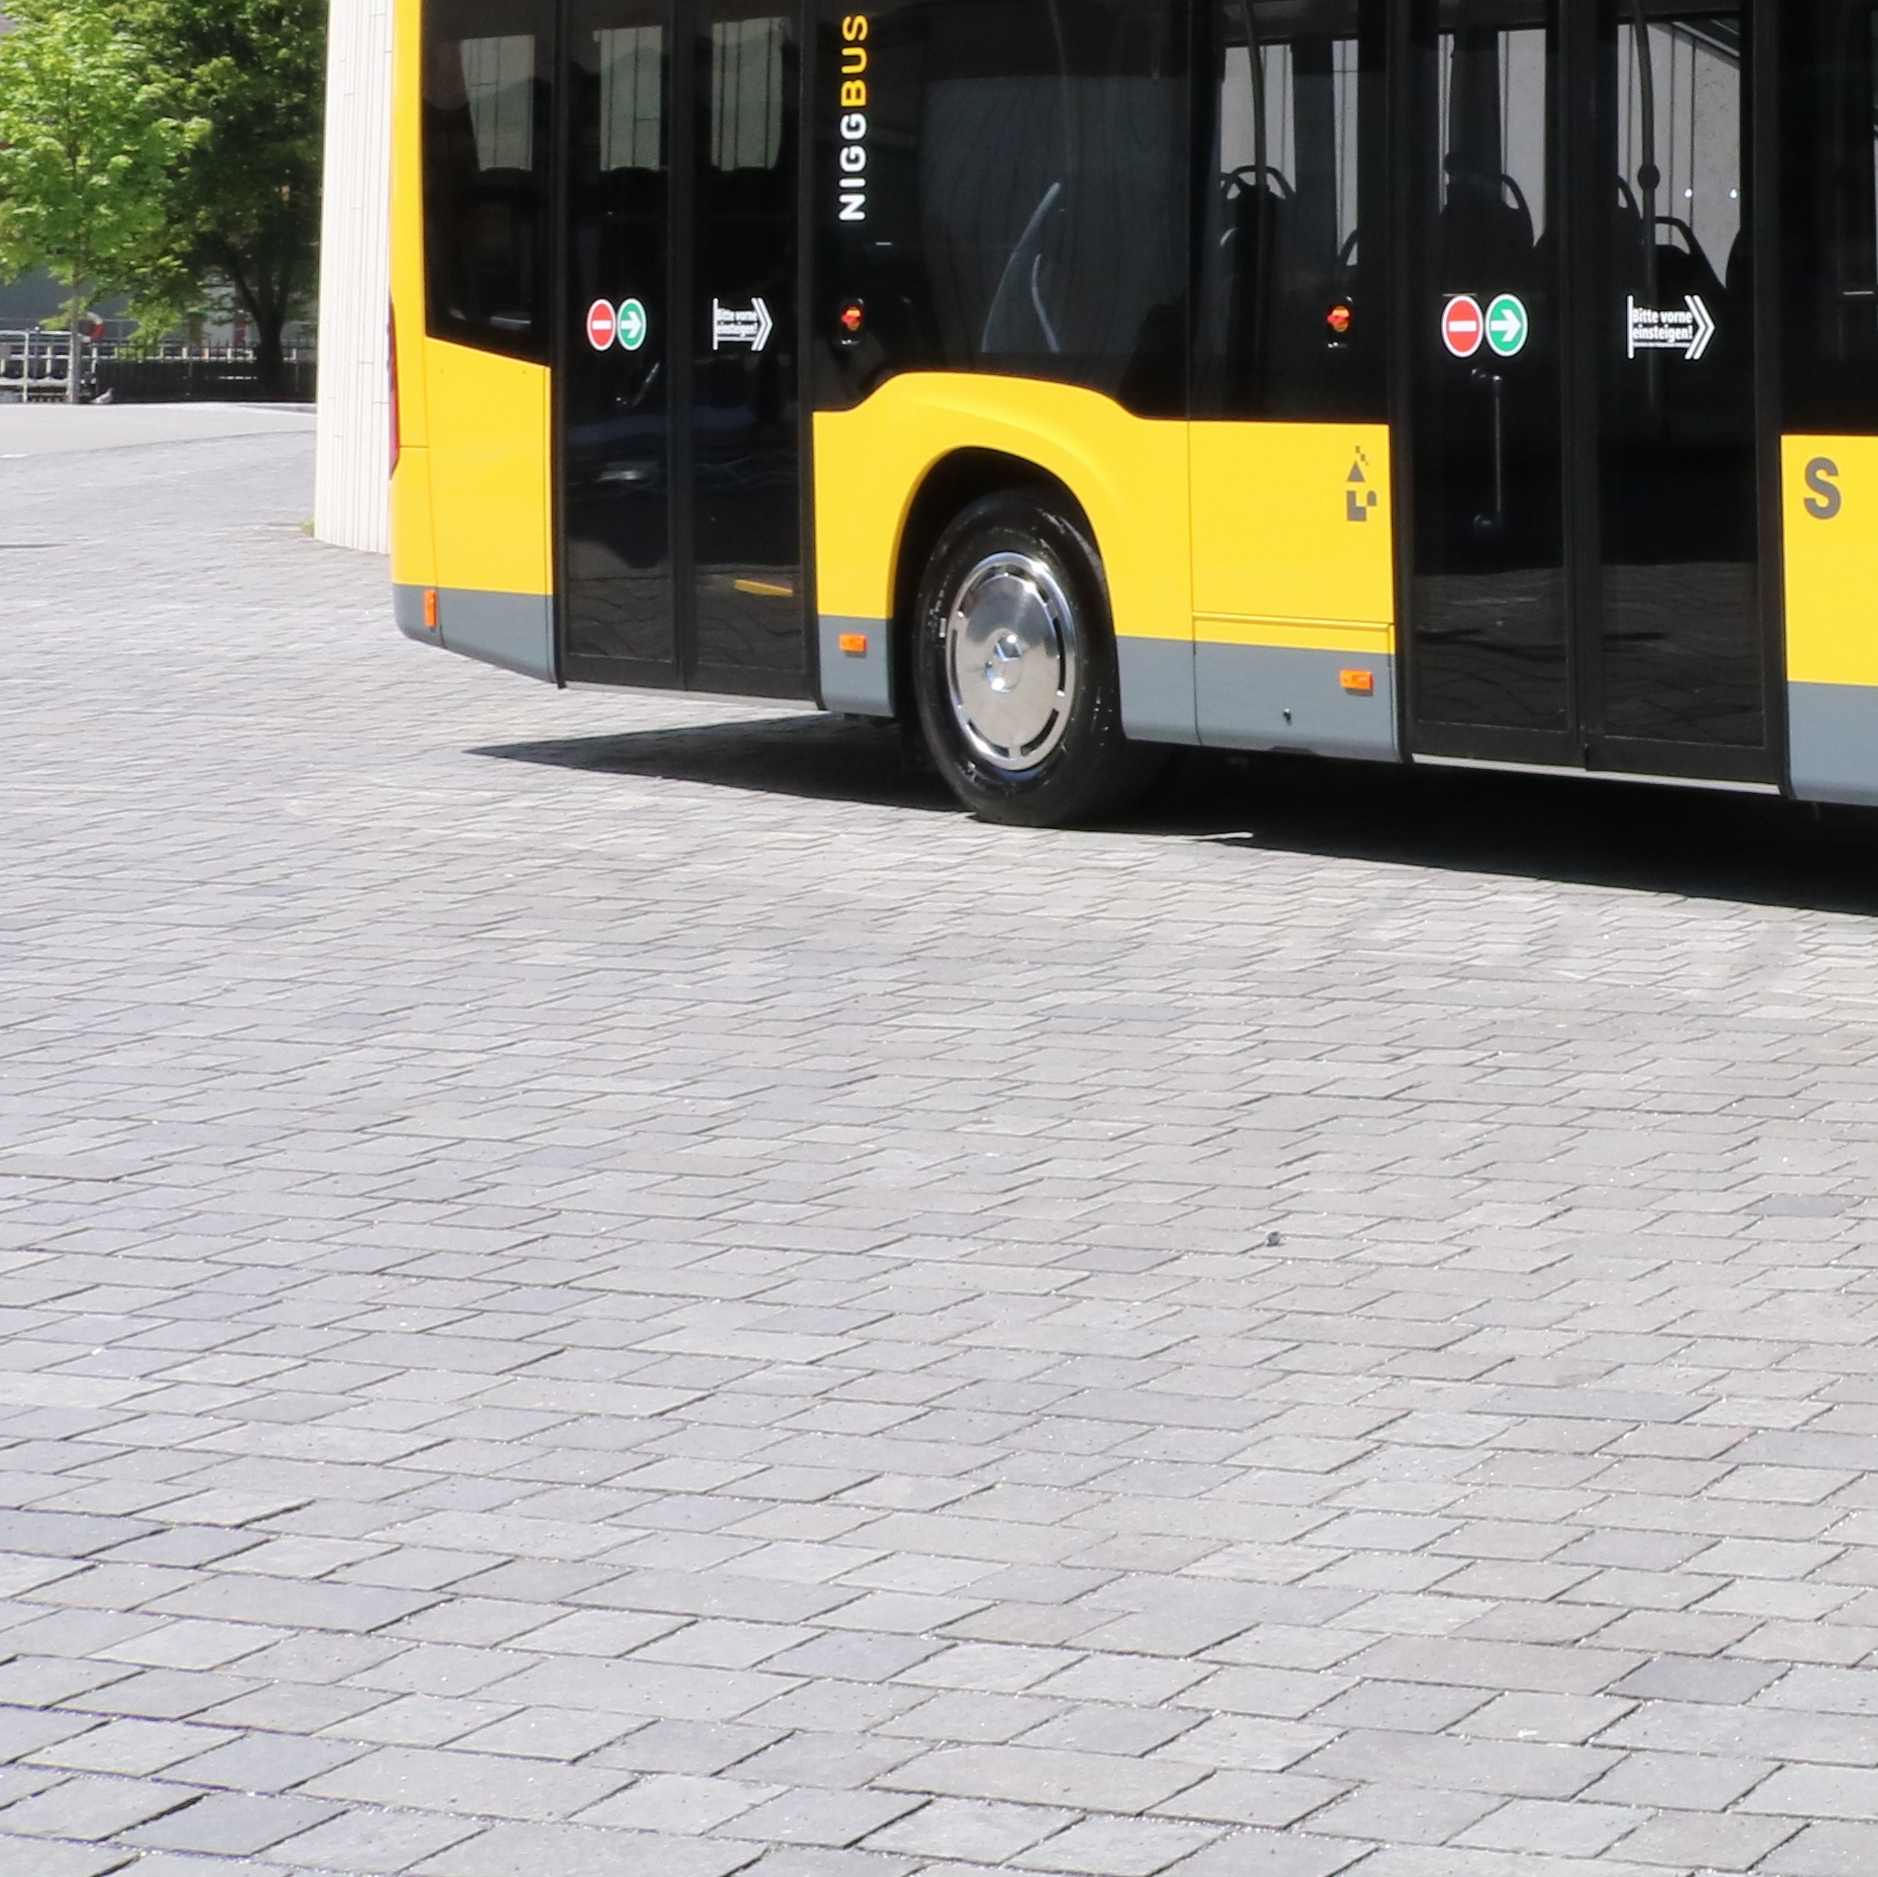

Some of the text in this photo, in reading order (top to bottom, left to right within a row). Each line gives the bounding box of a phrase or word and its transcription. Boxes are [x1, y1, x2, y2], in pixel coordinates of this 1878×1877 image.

[838, 13, 869, 222] NIGGBUS
[1633, 307, 1693, 323] Bitte vorne
[1633, 324, 1693, 343] einsteigen!
